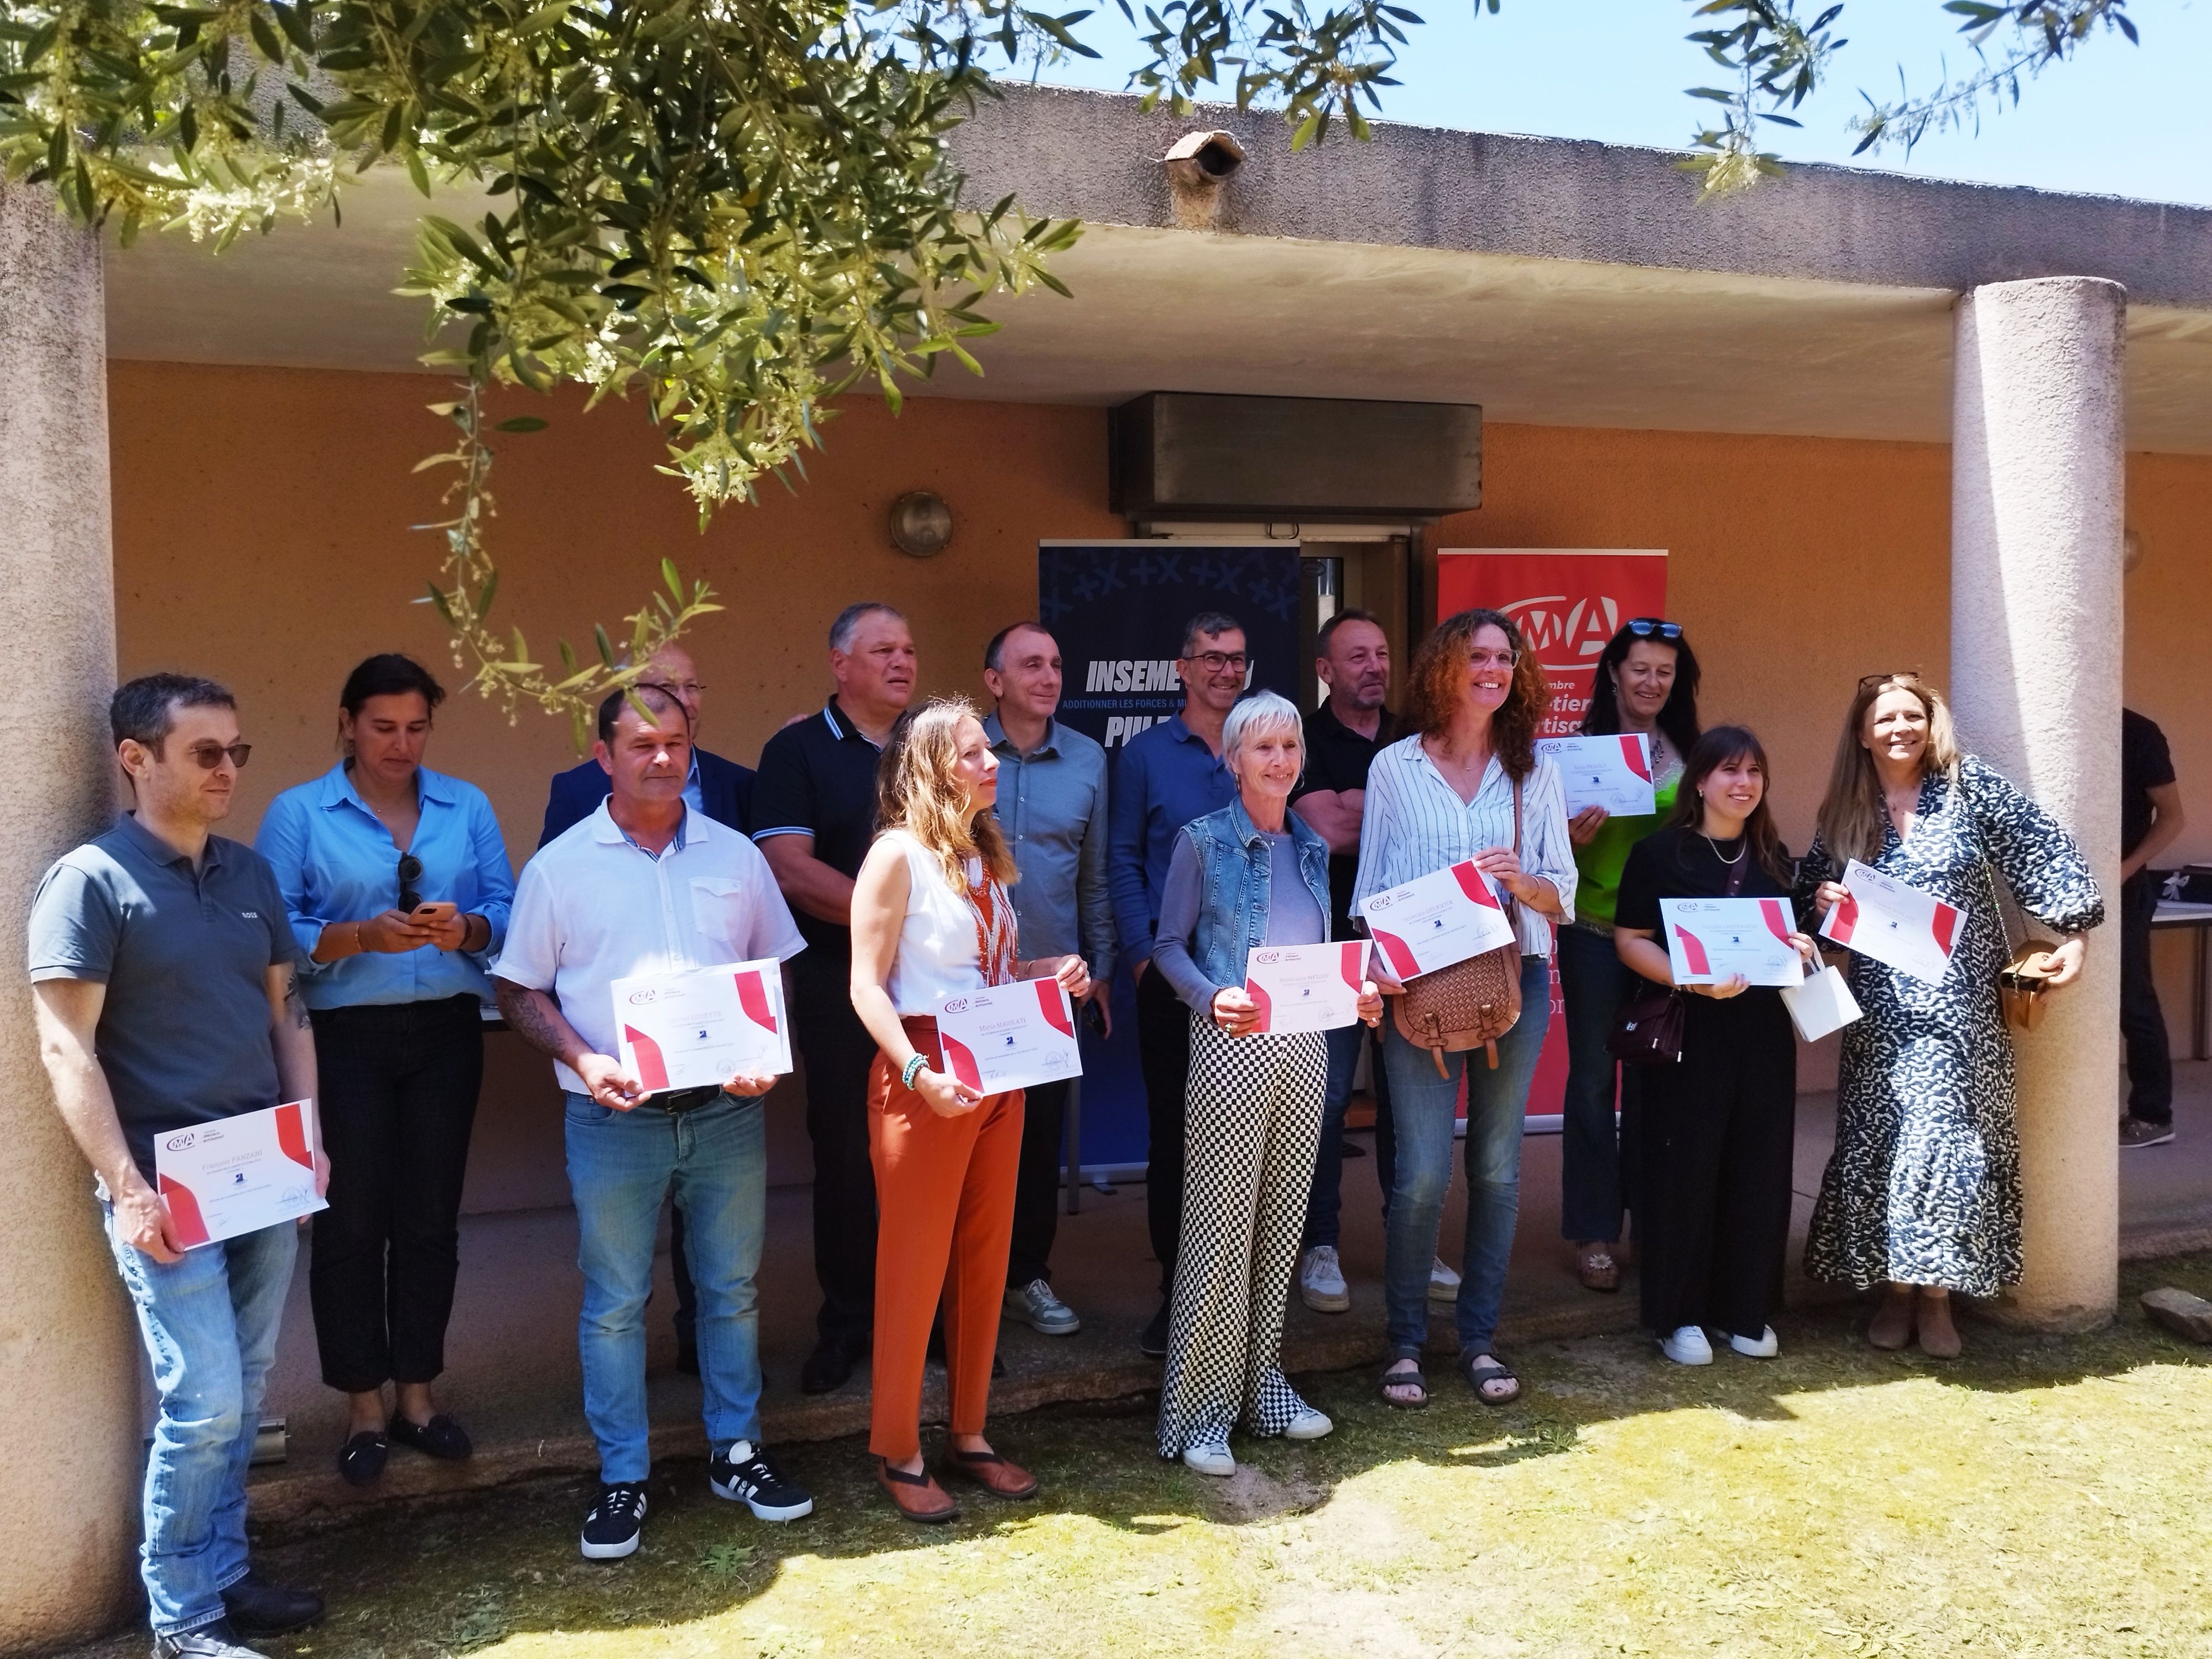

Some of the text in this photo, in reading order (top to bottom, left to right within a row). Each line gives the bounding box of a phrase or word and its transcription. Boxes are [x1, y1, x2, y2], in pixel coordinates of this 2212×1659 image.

[1086, 660, 1181, 692] INSEME
[1063, 700, 1118, 708] ADDITIONNER
[1119, 700, 1134, 708] LES
[1136, 699, 1167, 708] FORCES
[1169, 699, 1175, 707] &
[232, 1150, 263, 1163] PANZANI
